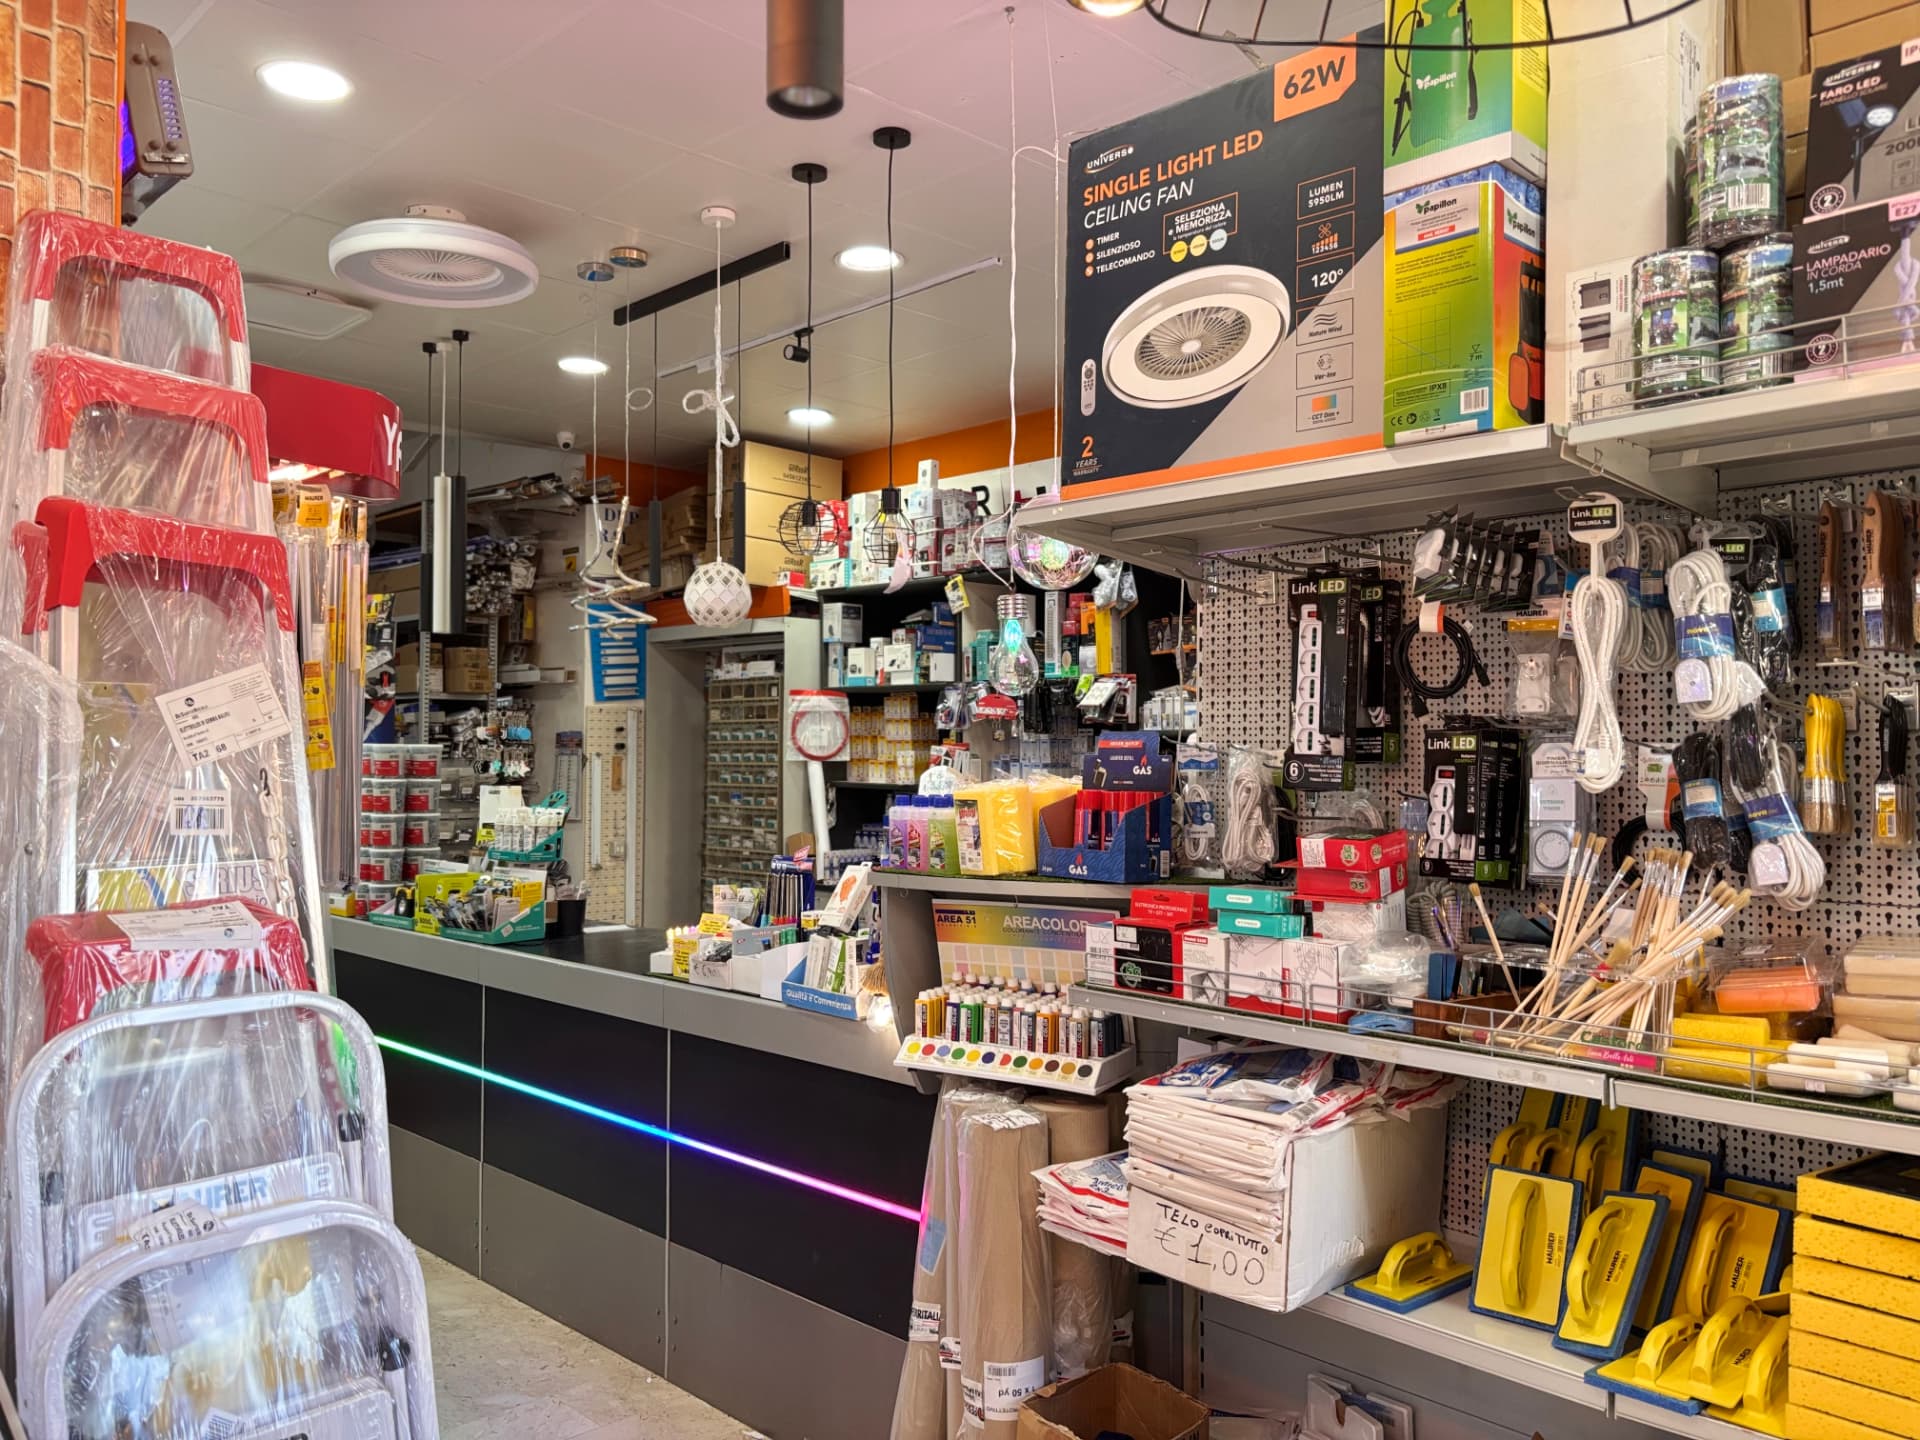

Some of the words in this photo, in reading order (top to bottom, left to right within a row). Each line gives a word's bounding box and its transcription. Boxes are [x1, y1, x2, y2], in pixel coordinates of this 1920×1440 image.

[1283, 55, 1346, 99] 62W
[1819, 84, 1854, 102] FARO
[1856, 75, 1882, 93] LED
[1083, 167, 1151, 207] SINGLE
[1157, 144, 1217, 182] LIGHT
[1222, 129, 1265, 160] LED
[1307, 190, 1345, 208] 5950LM
[1309, 180, 1344, 198] LUMEN
[1083, 191, 1152, 229] CEILING
[1156, 177, 1195, 207] FAN
[1174, 201, 1226, 225] SELEZIONA
[1423, 198, 1458, 215] papillon
[1895, 203, 1918, 218] E27
[1175, 209, 1233, 234] MEMORIZZA
[1513, 219, 1537, 239] papillon
[1096, 231, 1121, 246] TIMER
[1096, 239, 1142, 261] SILENZIOSO
[1805, 244, 1892, 273] LAMPADARIO
[1095, 249, 1156, 275] TELECOMANDO
[1806, 271, 1819, 281] IN
[1820, 260, 1863, 279] CORDA
[1310, 268, 1345, 289] 120°
[1808, 276, 1845, 295] 1,5mt
[1082, 435, 1094, 458] 2
[1075, 457, 1100, 468] YEARS
[1571, 509, 1592, 519] Link
[1593, 506, 1612, 517] LED
[1291, 582, 1318, 595] Link
[1319, 579, 1346, 594] LED
[1516, 609, 1549, 618] MAURER
[1427, 738, 1451, 751] Link
[1452, 736, 1476, 750] LED
[1132, 765, 1153, 776] GAS
[1288, 761, 1299, 777] 6
[1068, 863, 1088, 875] GAS
[936, 914, 963, 924] AREA
[966, 915, 977, 925] 51
[1002, 914, 1089, 934] AREACOLOR
[1156, 1201, 1200, 1229] TELO
[1546, 1232, 1555, 1265] MAURER
[1605, 1249, 1622, 1282] MAURER
[1730, 1256, 1745, 1289] MAURER
[998, 1386, 1010, 1398] yd
[1011, 1387, 1022, 1398] 50
